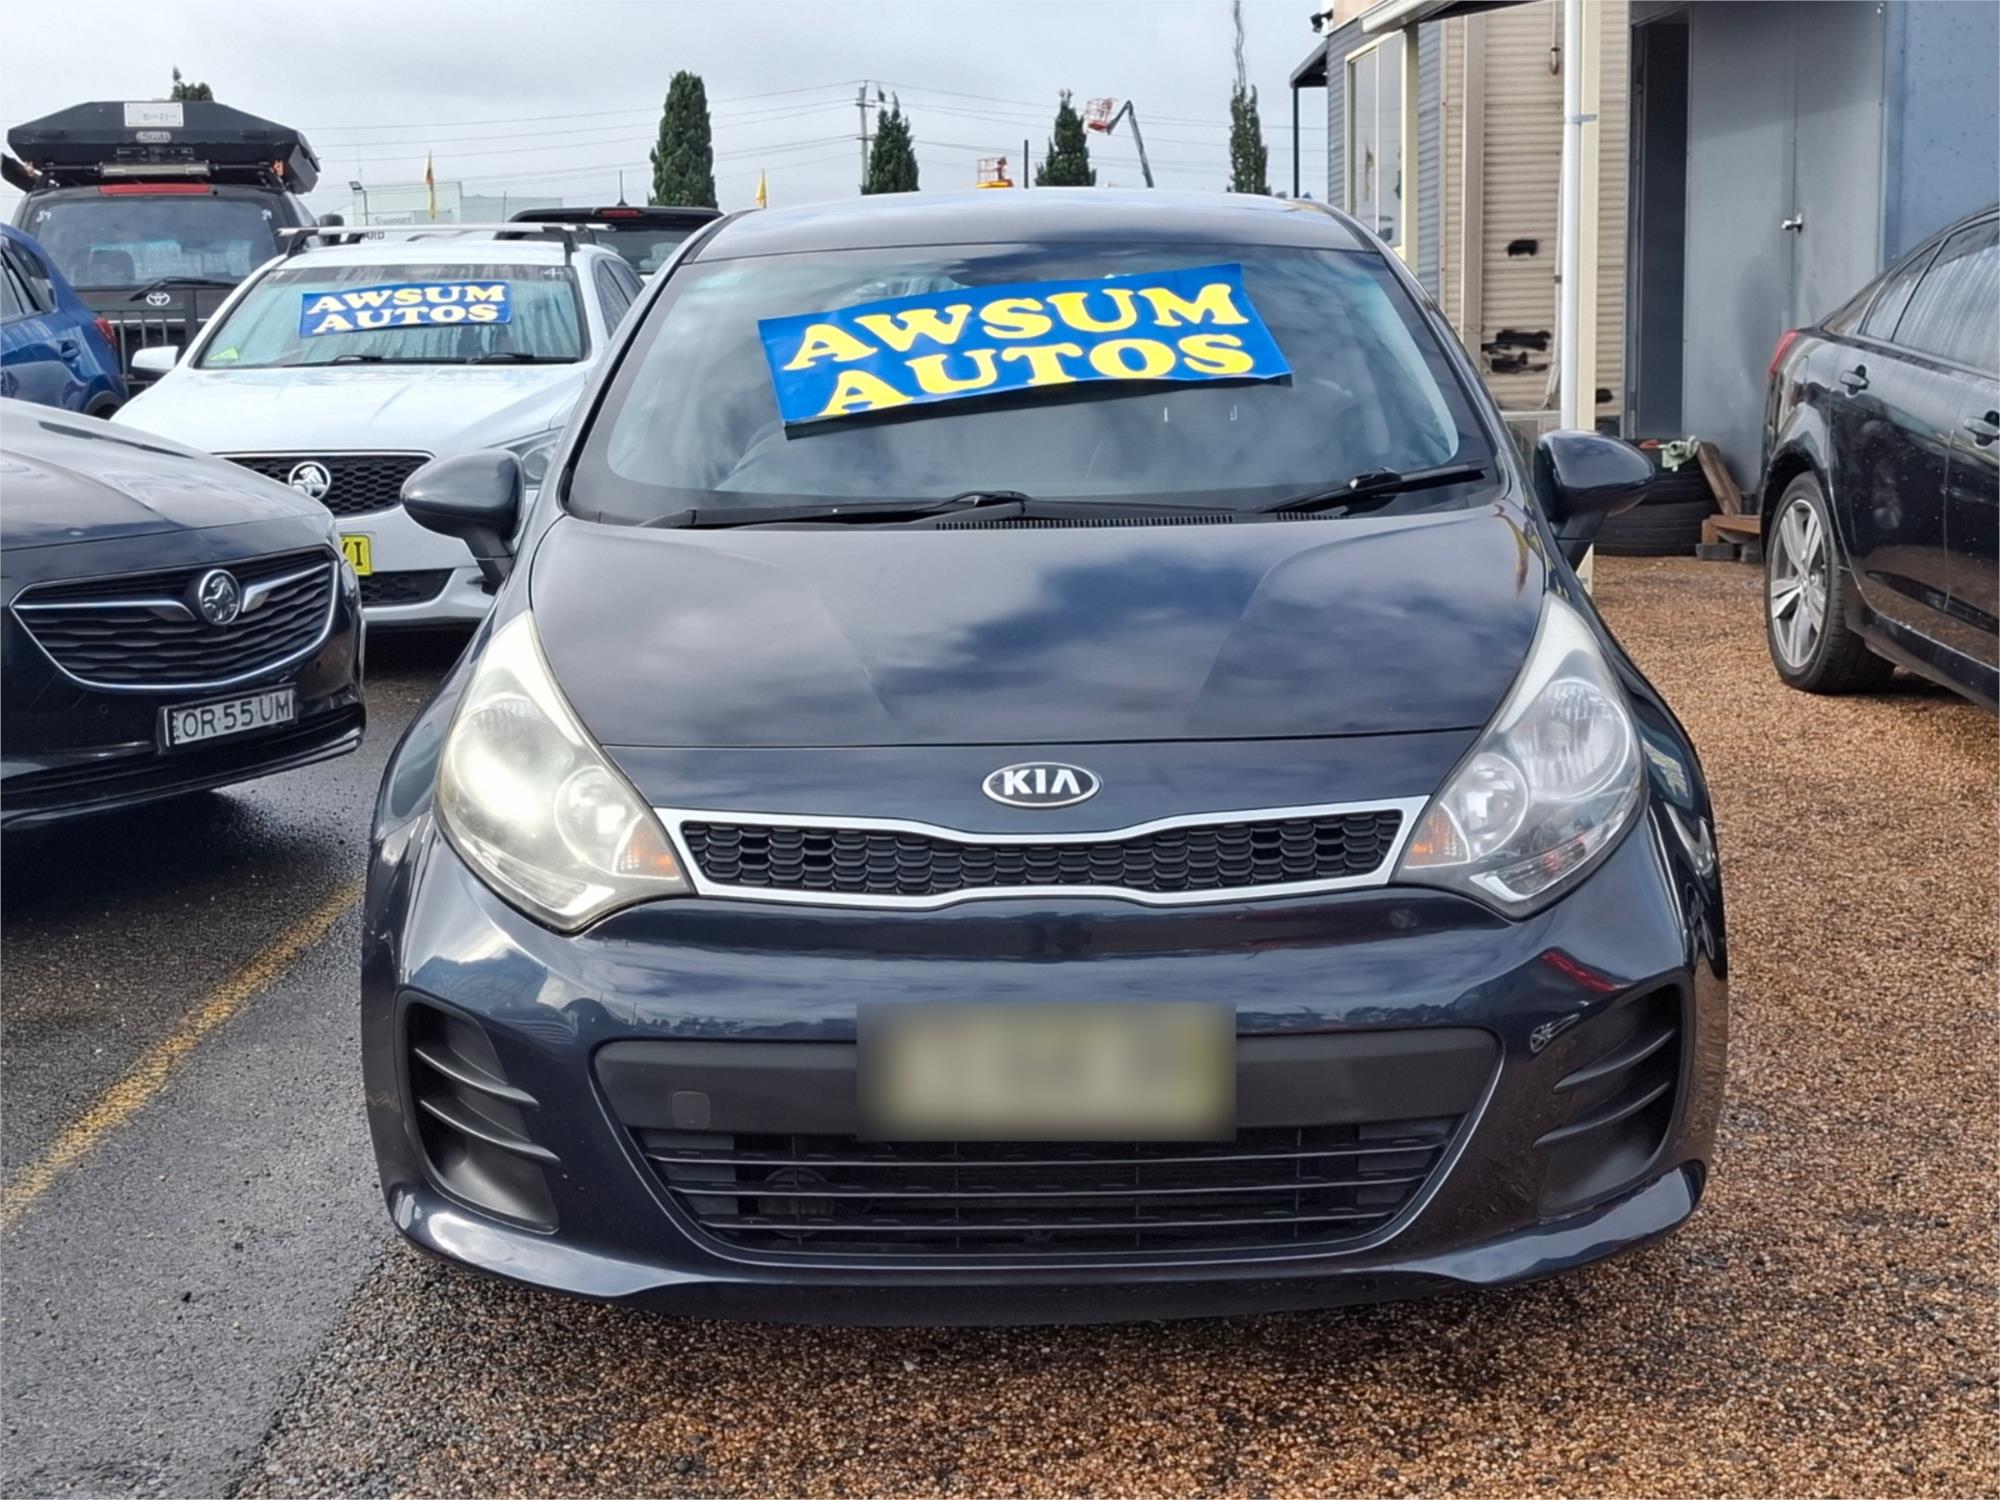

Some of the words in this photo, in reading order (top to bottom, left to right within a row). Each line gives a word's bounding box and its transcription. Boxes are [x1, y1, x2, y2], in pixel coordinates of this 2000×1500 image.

[306, 285, 506, 314] AWSUM
[312, 303, 499, 334] AUTOS
[783, 283, 1249, 371] AWSUM
[818, 334, 1254, 416] AUTOS
[1002, 768, 1081, 796] KIA
